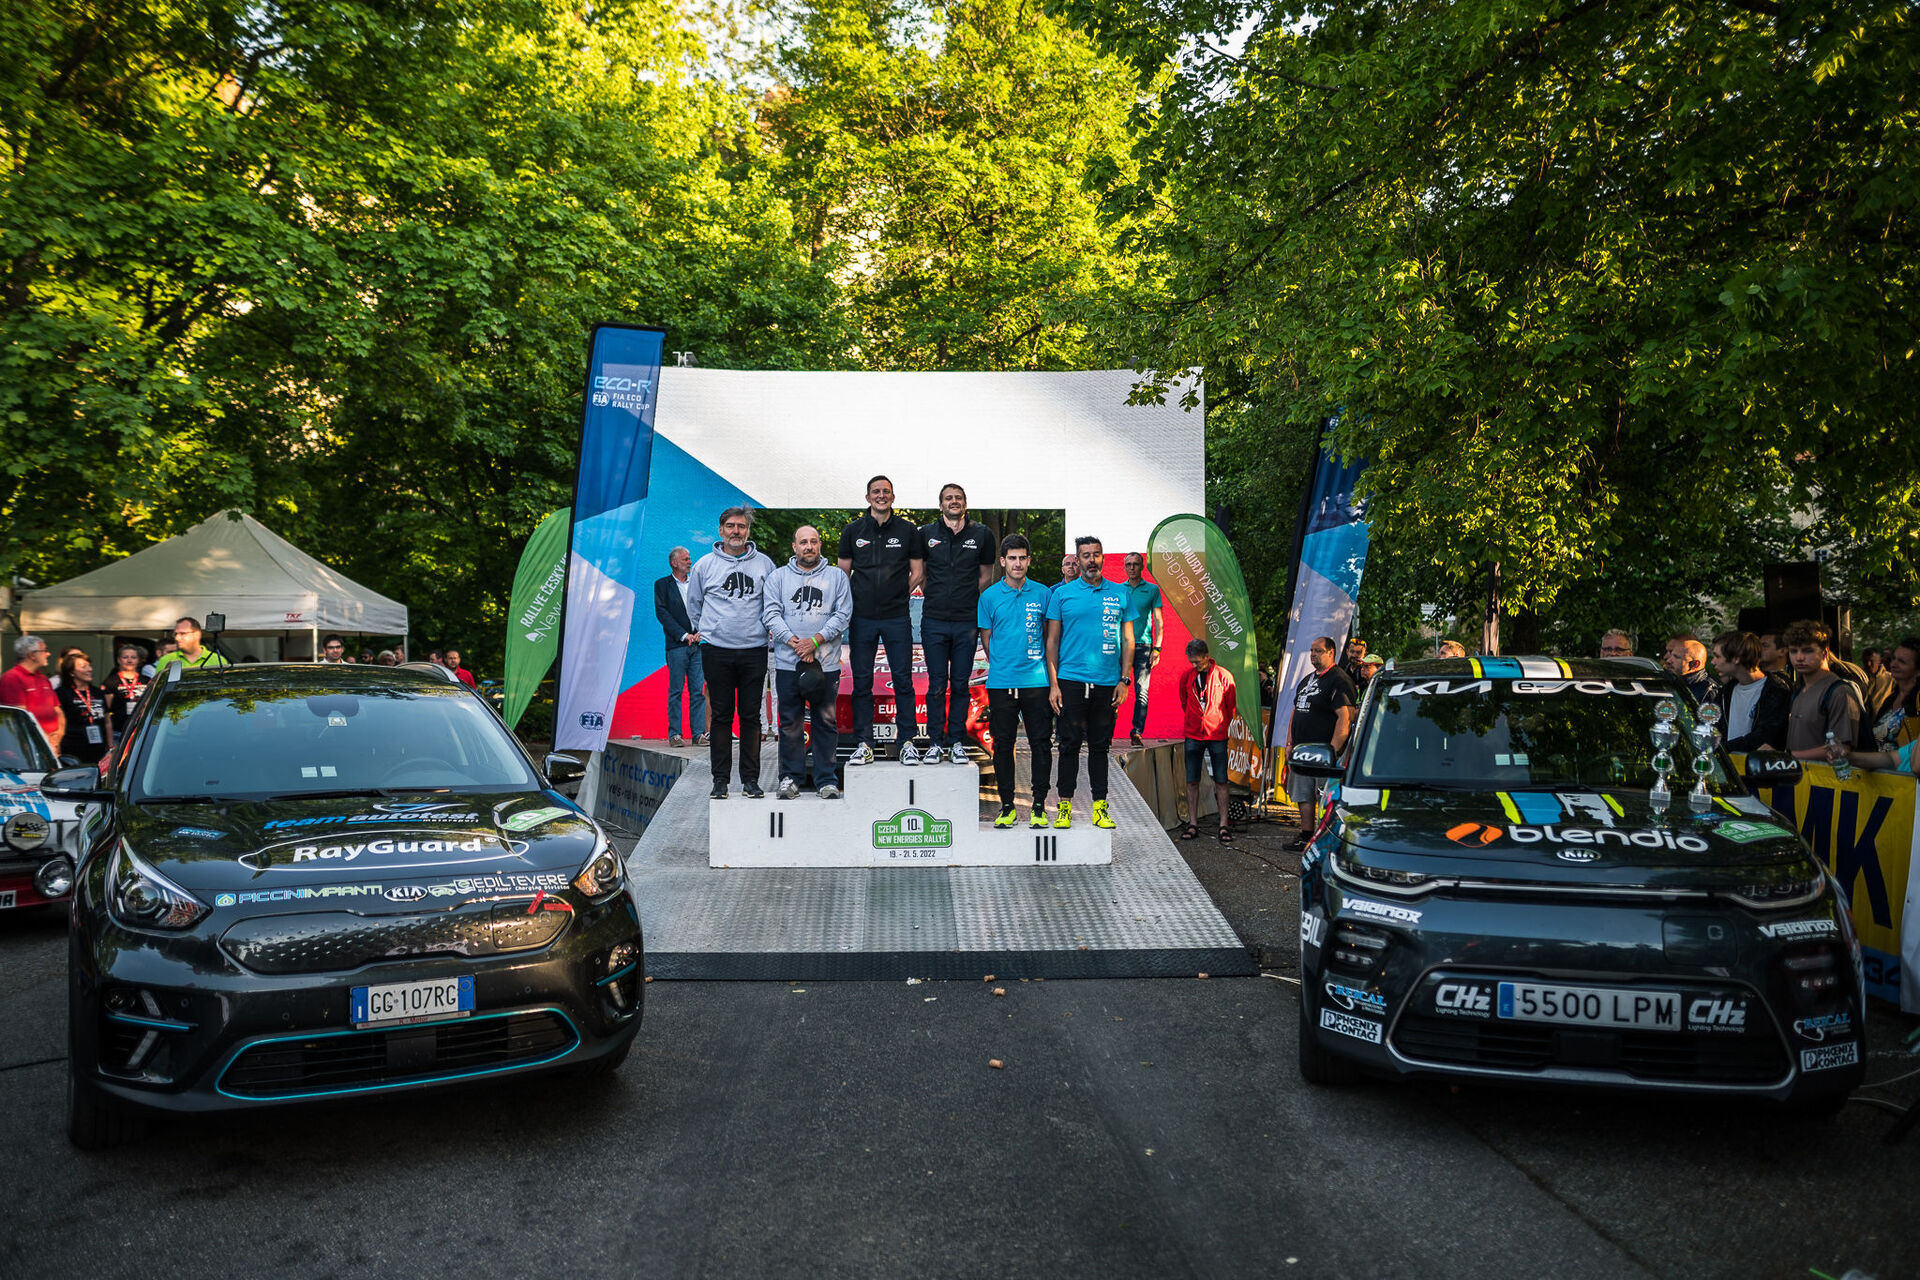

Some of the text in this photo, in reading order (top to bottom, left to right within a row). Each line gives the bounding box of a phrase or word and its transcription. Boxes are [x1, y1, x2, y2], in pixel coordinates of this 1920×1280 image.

[593, 394, 607, 404] FIA
[627, 394, 642, 402] ECO
[612, 401, 633, 409] RALLY
[520, 594, 548, 628] RALLYE
[581, 715, 603, 727] FIA
[770, 812, 784, 838] II
[878, 825, 898, 833] CZECH
[931, 825, 947, 833] 2022
[878, 834, 946, 844] NEW ENERGIES RALLYE
[1508, 826, 1709, 851] blendio
[920, 850, 936, 858] 2022
[1035, 836, 1057, 861] III
[1563, 850, 1596, 860] KIA
[474, 874, 568, 888] EDILTEVERE
[392, 887, 422, 898] KIA
[1521, 989, 1673, 1025] 5500 LPM
[1336, 1023, 1377, 1040] CONTACT
